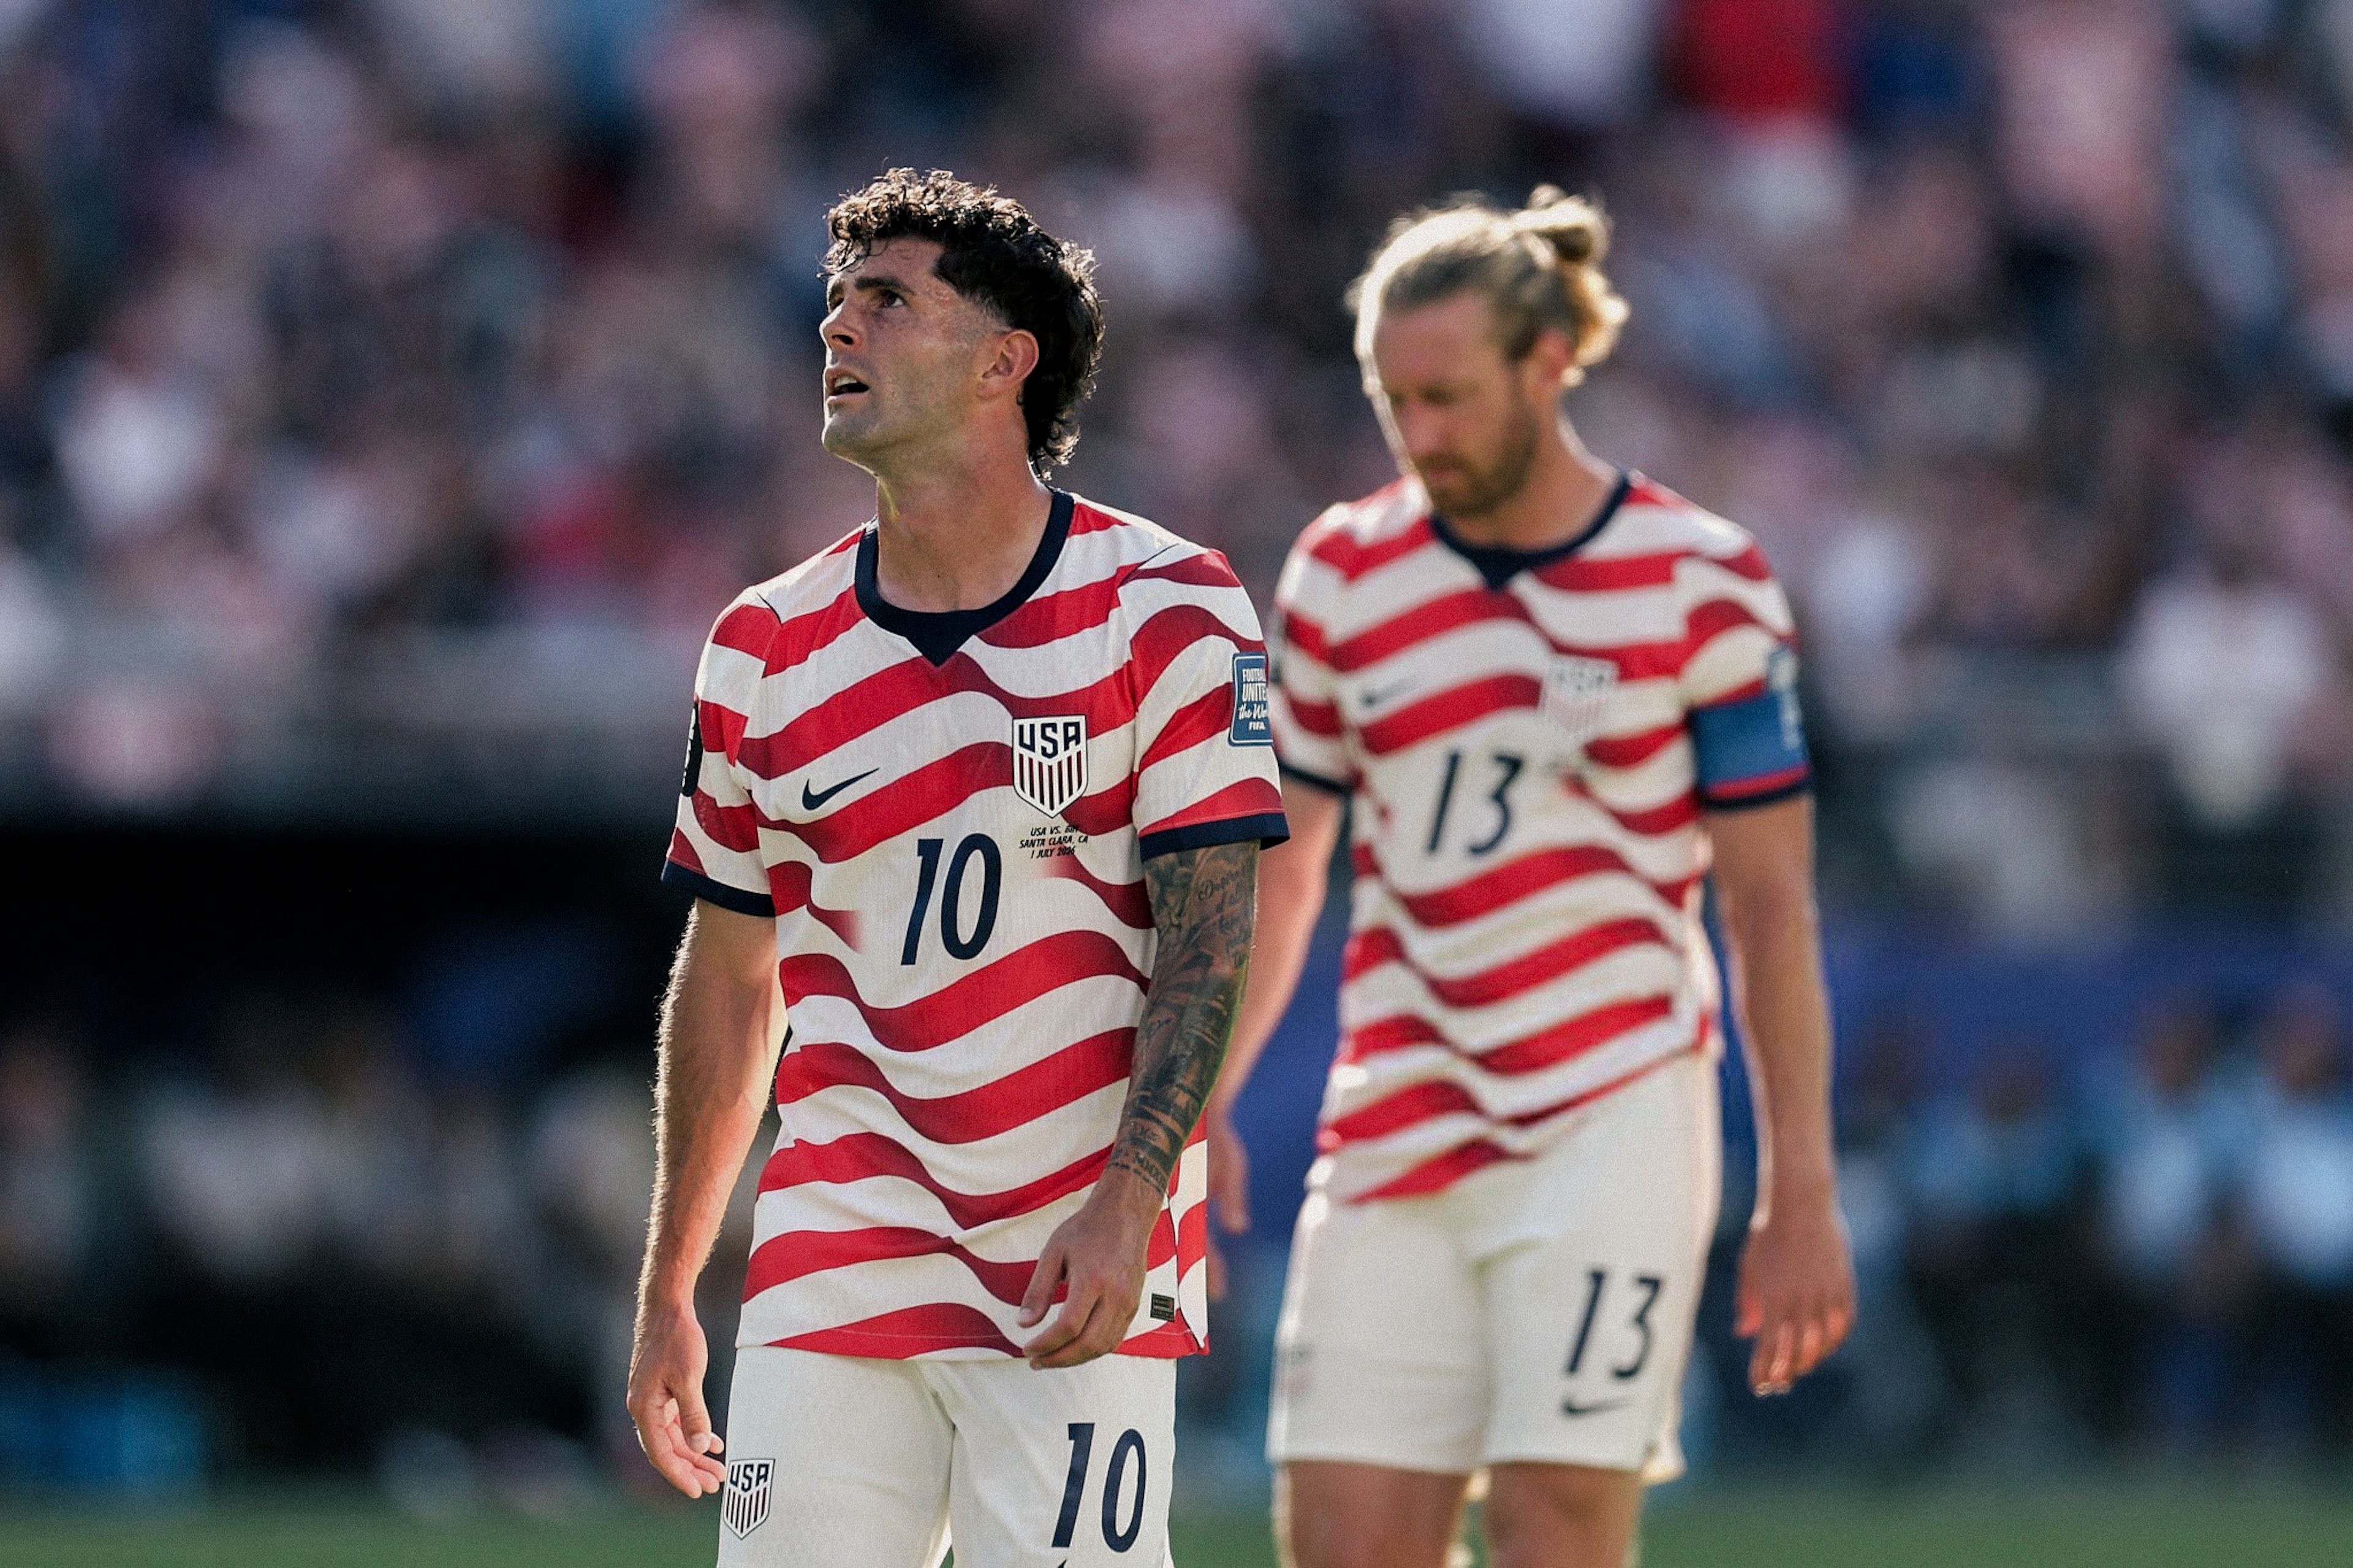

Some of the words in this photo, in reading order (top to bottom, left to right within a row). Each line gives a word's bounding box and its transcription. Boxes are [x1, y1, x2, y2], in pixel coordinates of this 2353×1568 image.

[1018, 721, 1081, 759] USA
[1248, 722, 1266, 730] FIFA
[1428, 752, 1523, 855] 13
[1019, 838, 1045, 849] SANTA
[1078, 835, 1088, 844] CA
[1031, 827, 1047, 836] USA
[1050, 826, 1061, 835] VS.
[1031, 850, 1034, 858] 1
[1036, 848, 1055, 858] JULY
[1057, 846, 1076, 856] 2026
[901, 833, 1002, 966] 10
[1566, 1270, 1661, 1380] 13
[729, 1463, 770, 1493] USA
[1051, 1423, 1146, 1553] 10
